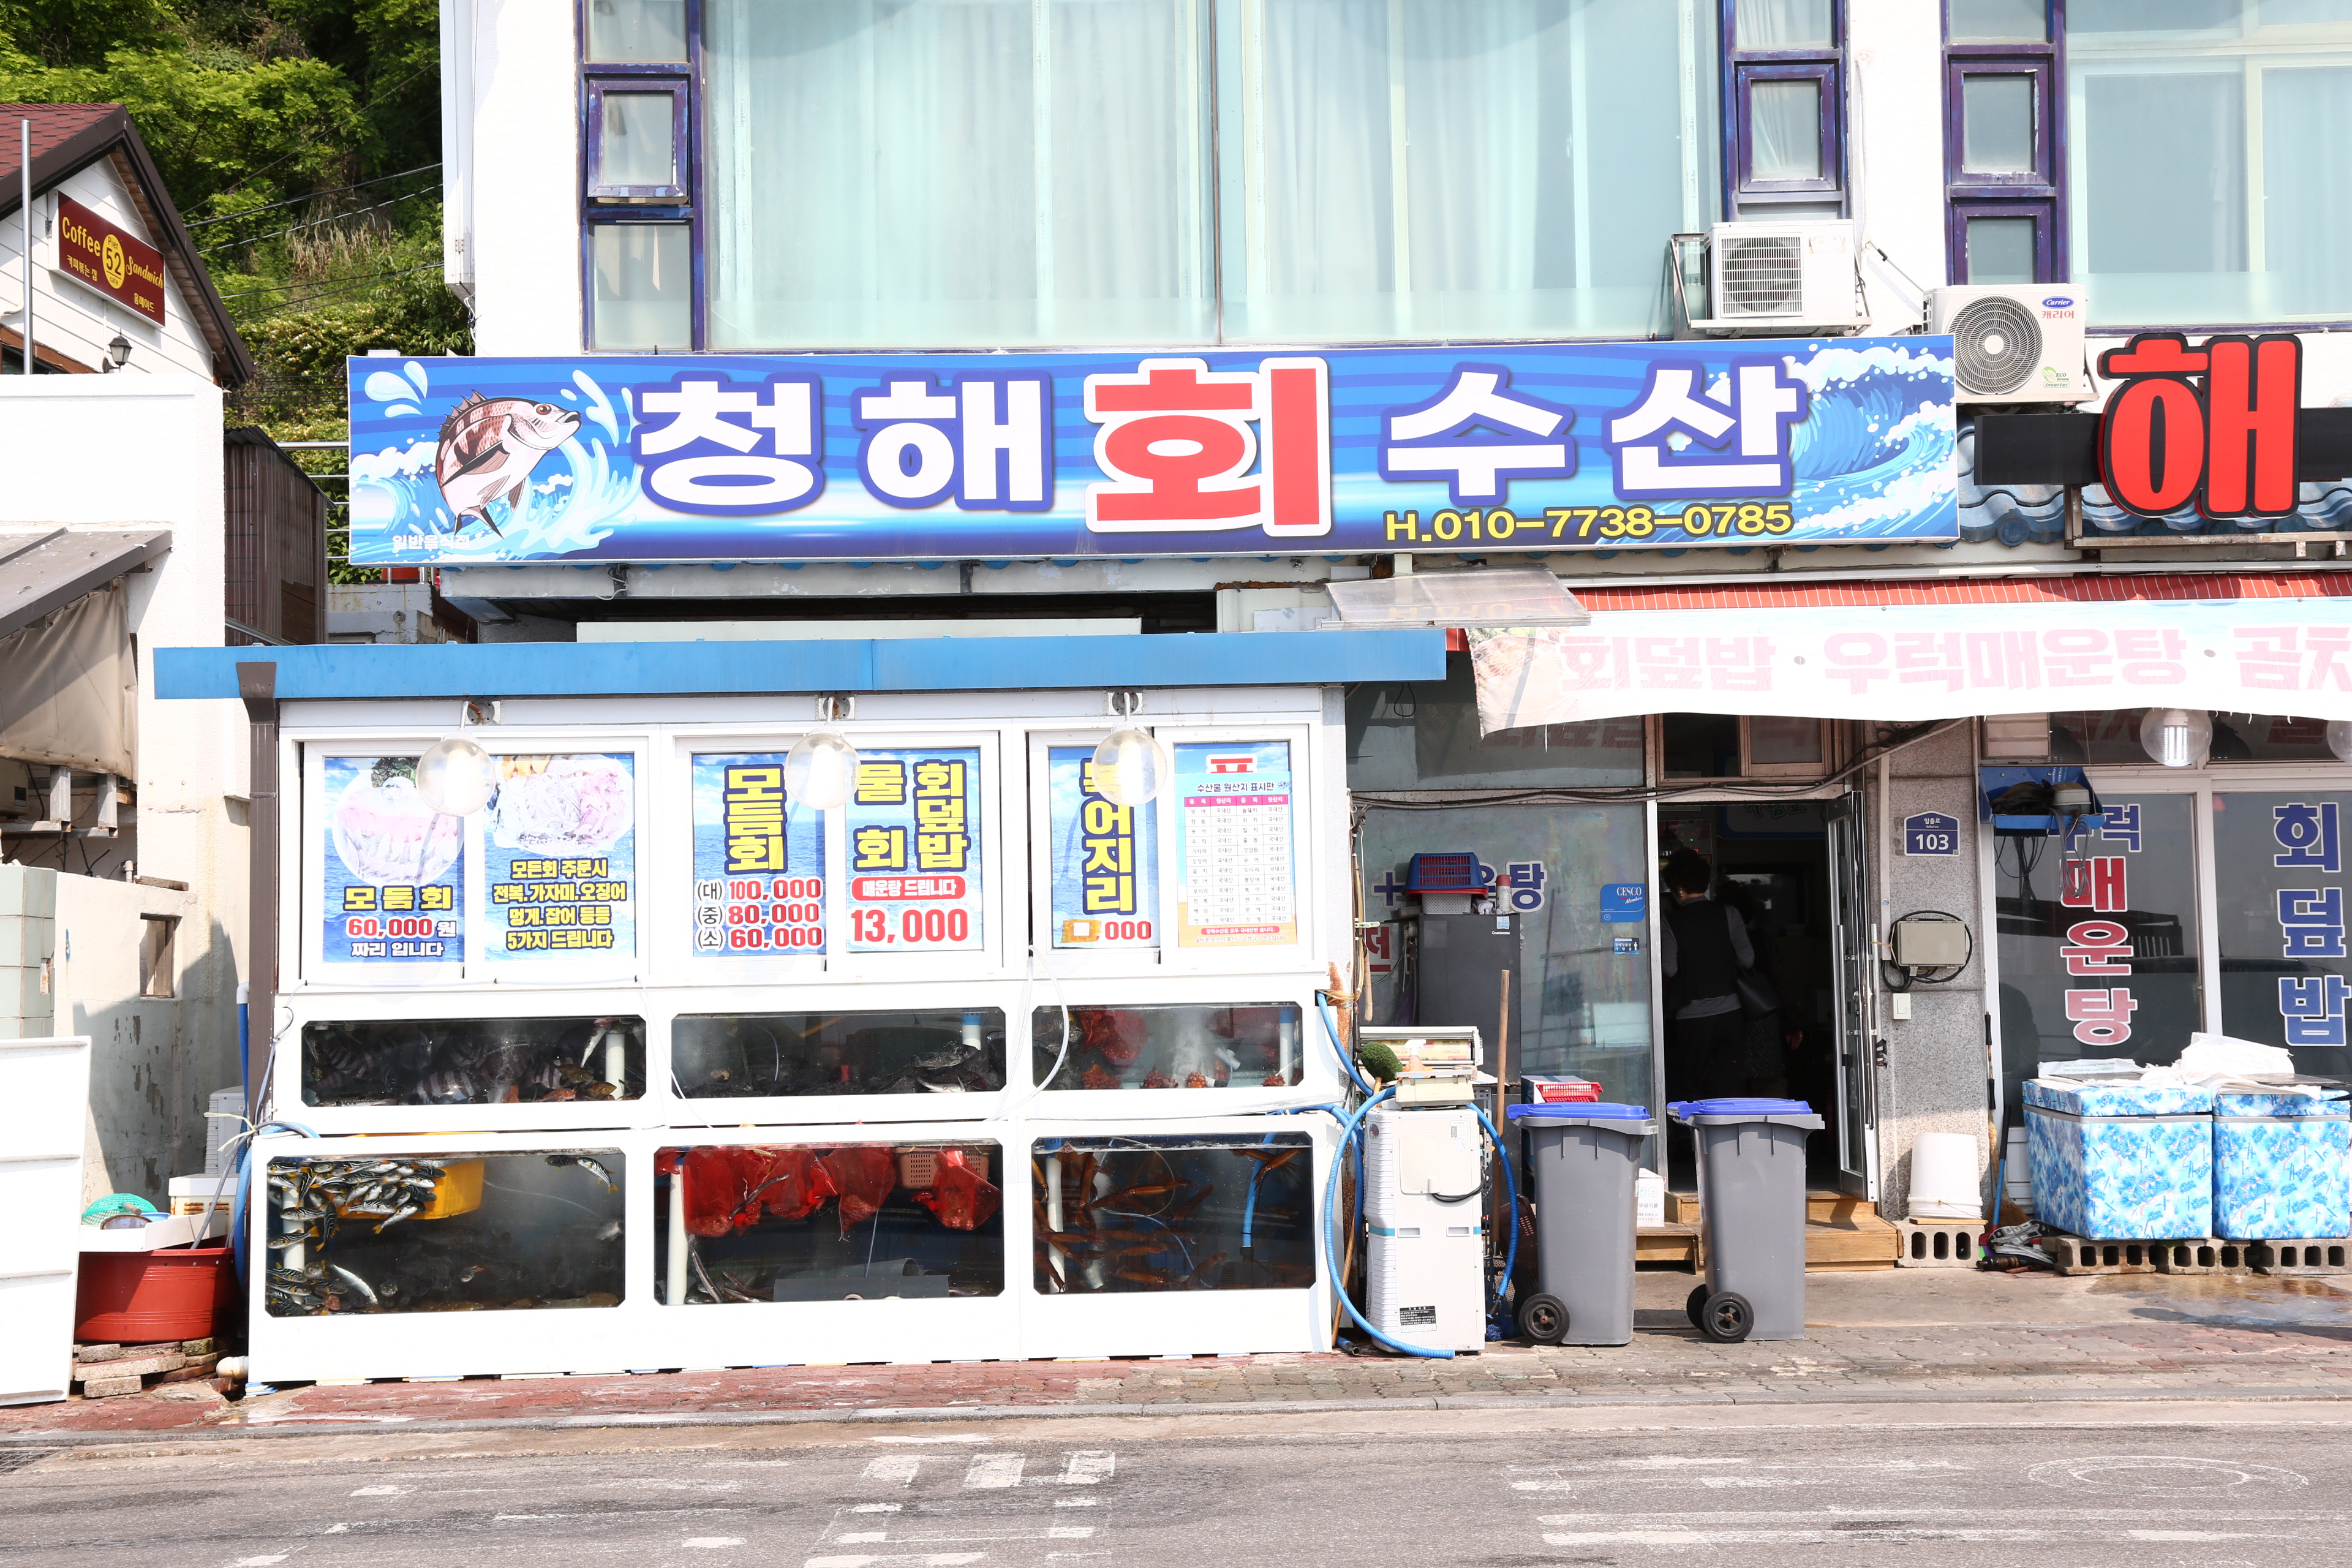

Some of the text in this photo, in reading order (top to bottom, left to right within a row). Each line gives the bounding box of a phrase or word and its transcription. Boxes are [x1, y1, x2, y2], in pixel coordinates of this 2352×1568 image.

[62, 216, 101, 257] Coffee
[107, 236, 119, 250] Pier
[105, 247, 122, 276] 52
[126, 255, 164, 289] Sandwich
[2041, 310, 2075, 319] 캐리어
[392, 534, 470, 549] 일반음식점
[1561, 633, 1773, 692] 회덮밥
[1823, 628, 2187, 693] 우럭매운탕
[1197, 782, 1275, 793] 수산물 원산지 표시판
[726, 767, 784, 871] 모듬회
[916, 763, 968, 869] 회덮밥
[1915, 834, 1949, 850] 103
[512, 859, 606, 878] 모든회 주문시
[344, 886, 451, 910] 모듬회
[698, 880, 821, 901] (대) 100,000
[862, 878, 957, 897] 매운탕 드립니다
[1616, 887, 1642, 896] CESCO
[580, 907, 611, 925] 등등
[698, 903, 820, 924] (중) 80,000
[2274, 802, 2351, 1046] 회덮밥
[850, 908, 968, 943] 13,000
[507, 930, 612, 949] 5가지 드립니다
[698, 927, 822, 948] (소) 60,000
[352, 942, 444, 957] 짜리 입니다
[2060, 856, 2138, 1046] 매운탕
